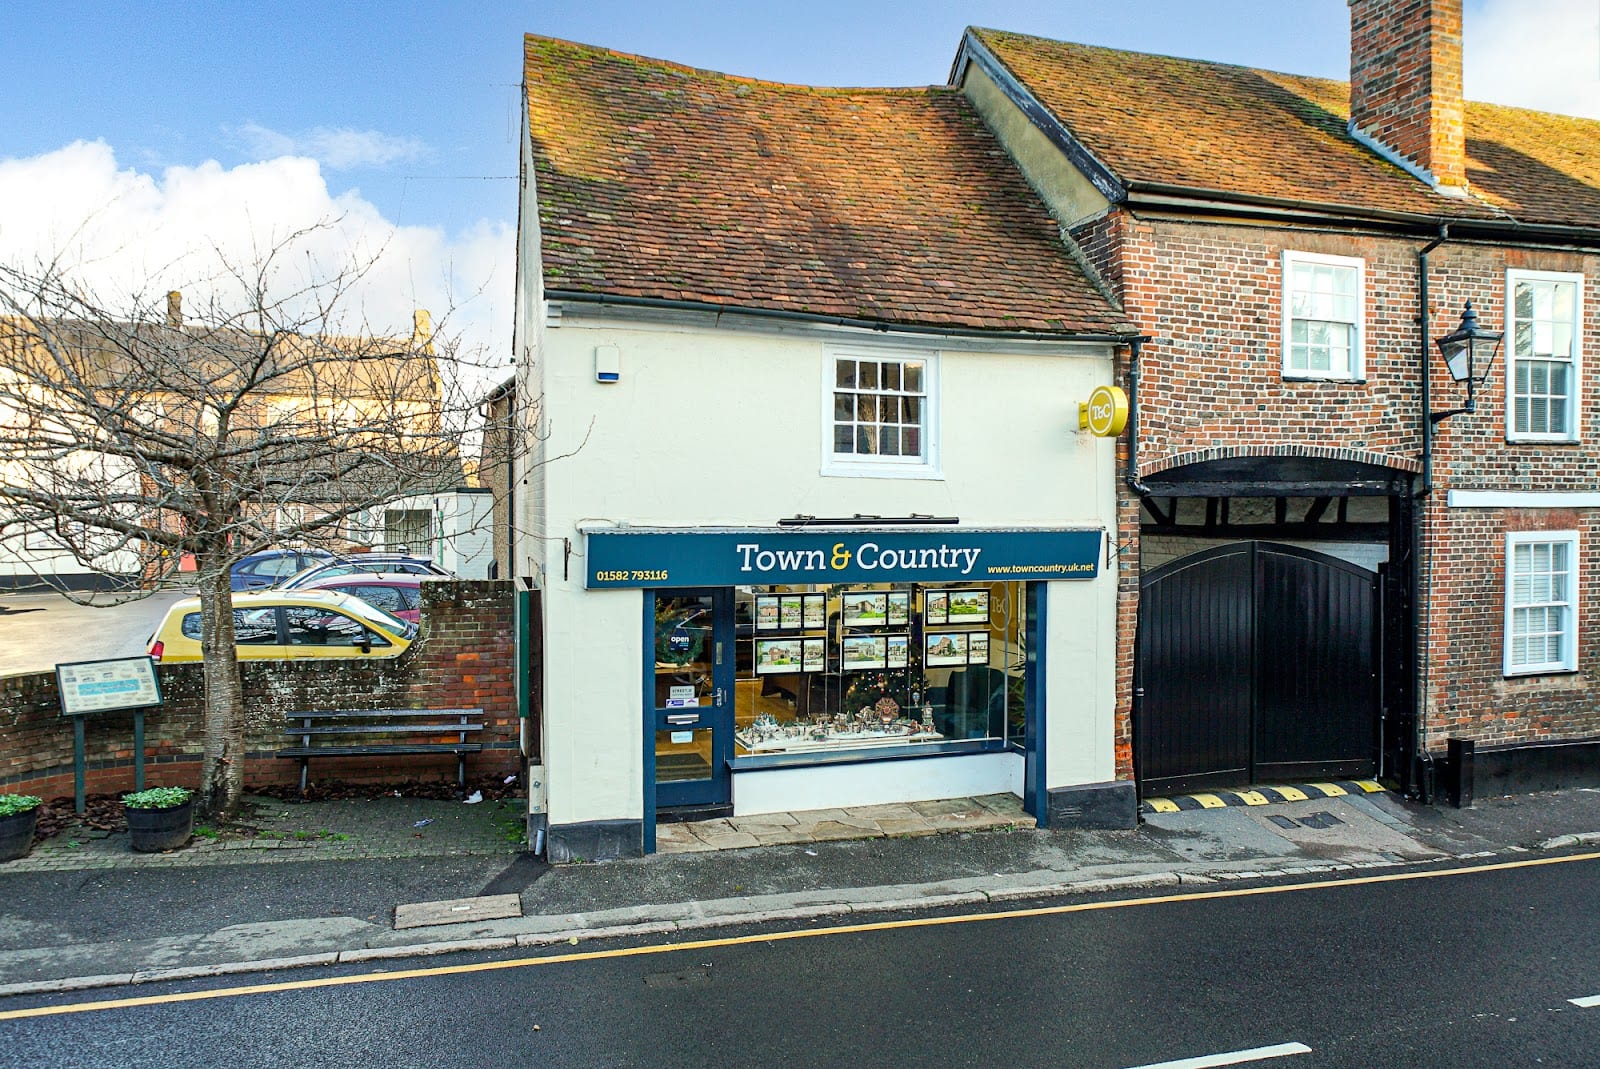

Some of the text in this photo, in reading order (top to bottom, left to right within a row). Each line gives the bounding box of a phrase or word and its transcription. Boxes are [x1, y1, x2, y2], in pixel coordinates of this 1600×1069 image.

[1092, 404, 1111, 420] T&C
[736, 543, 981, 574] Town & Country
[987, 563, 1094, 574] www.towncountry.uk.net
[596, 570, 668, 581] 01582 793116
[670, 636, 690, 644] open
